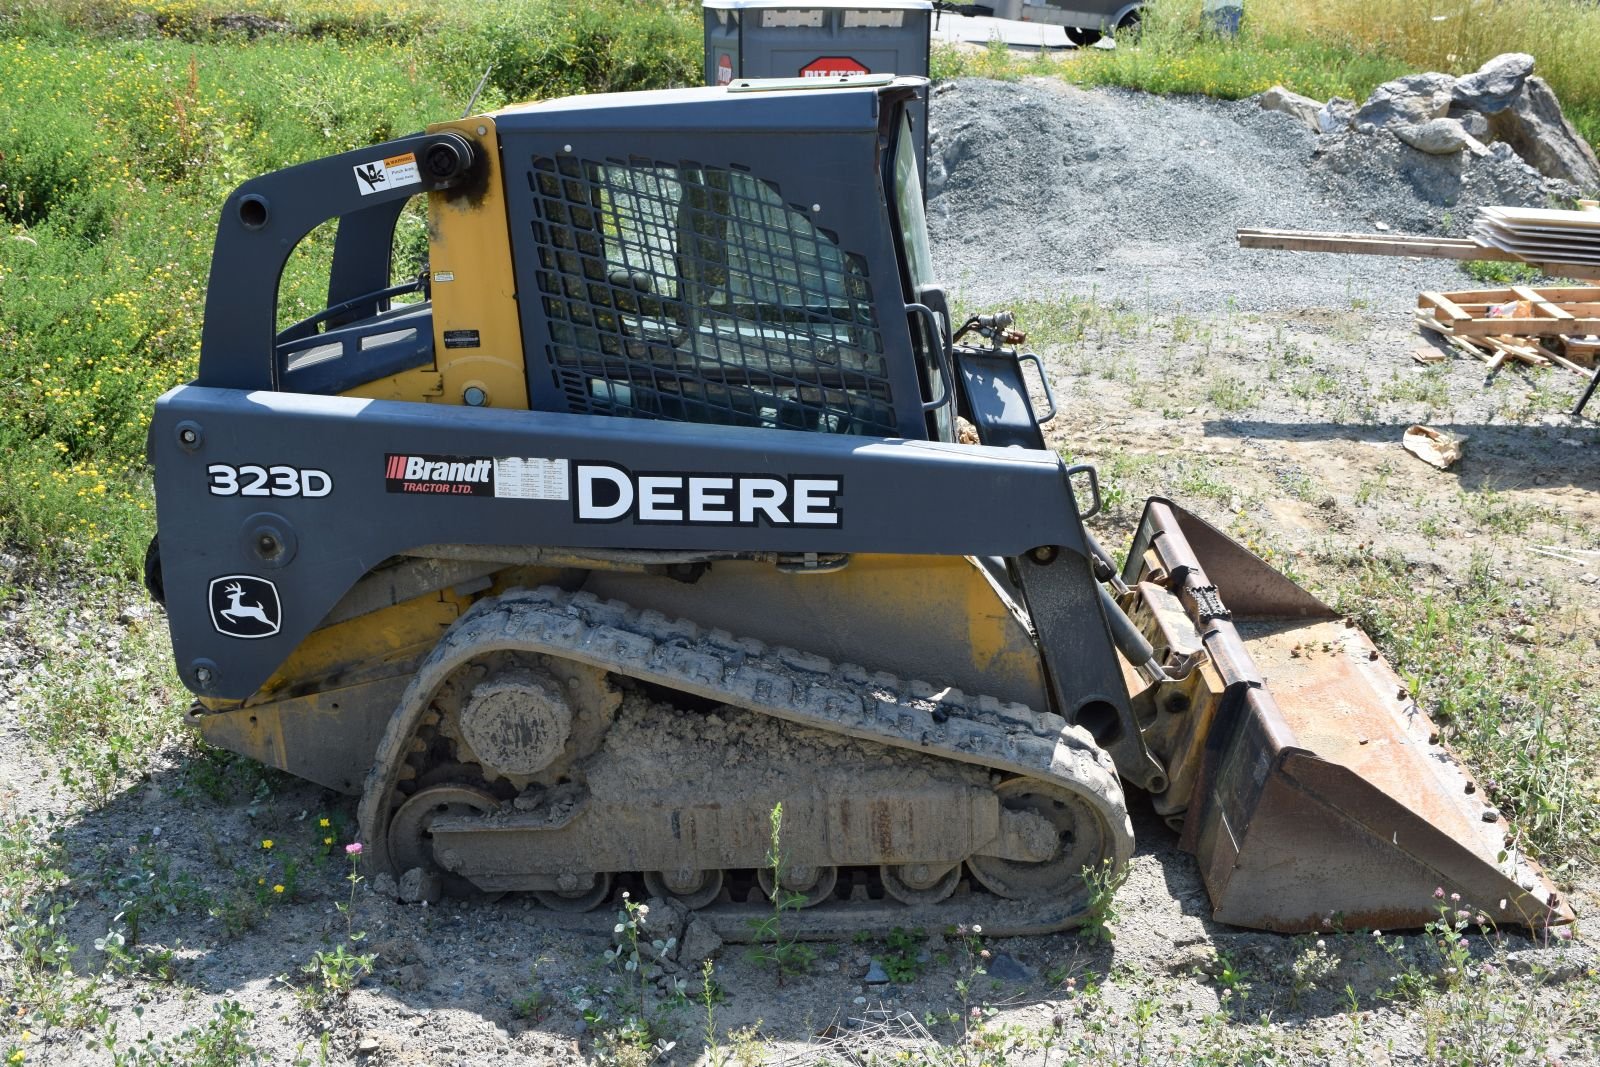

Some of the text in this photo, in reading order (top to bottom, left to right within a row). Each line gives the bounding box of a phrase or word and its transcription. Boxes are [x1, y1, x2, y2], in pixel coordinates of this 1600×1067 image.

[390, 156, 413, 164] WARNING
[208, 464, 333, 497] 323D
[404, 456, 492, 483] Brandt
[402, 482, 473, 494] TRACTOR LTD.
[577, 465, 839, 524] DEERE
